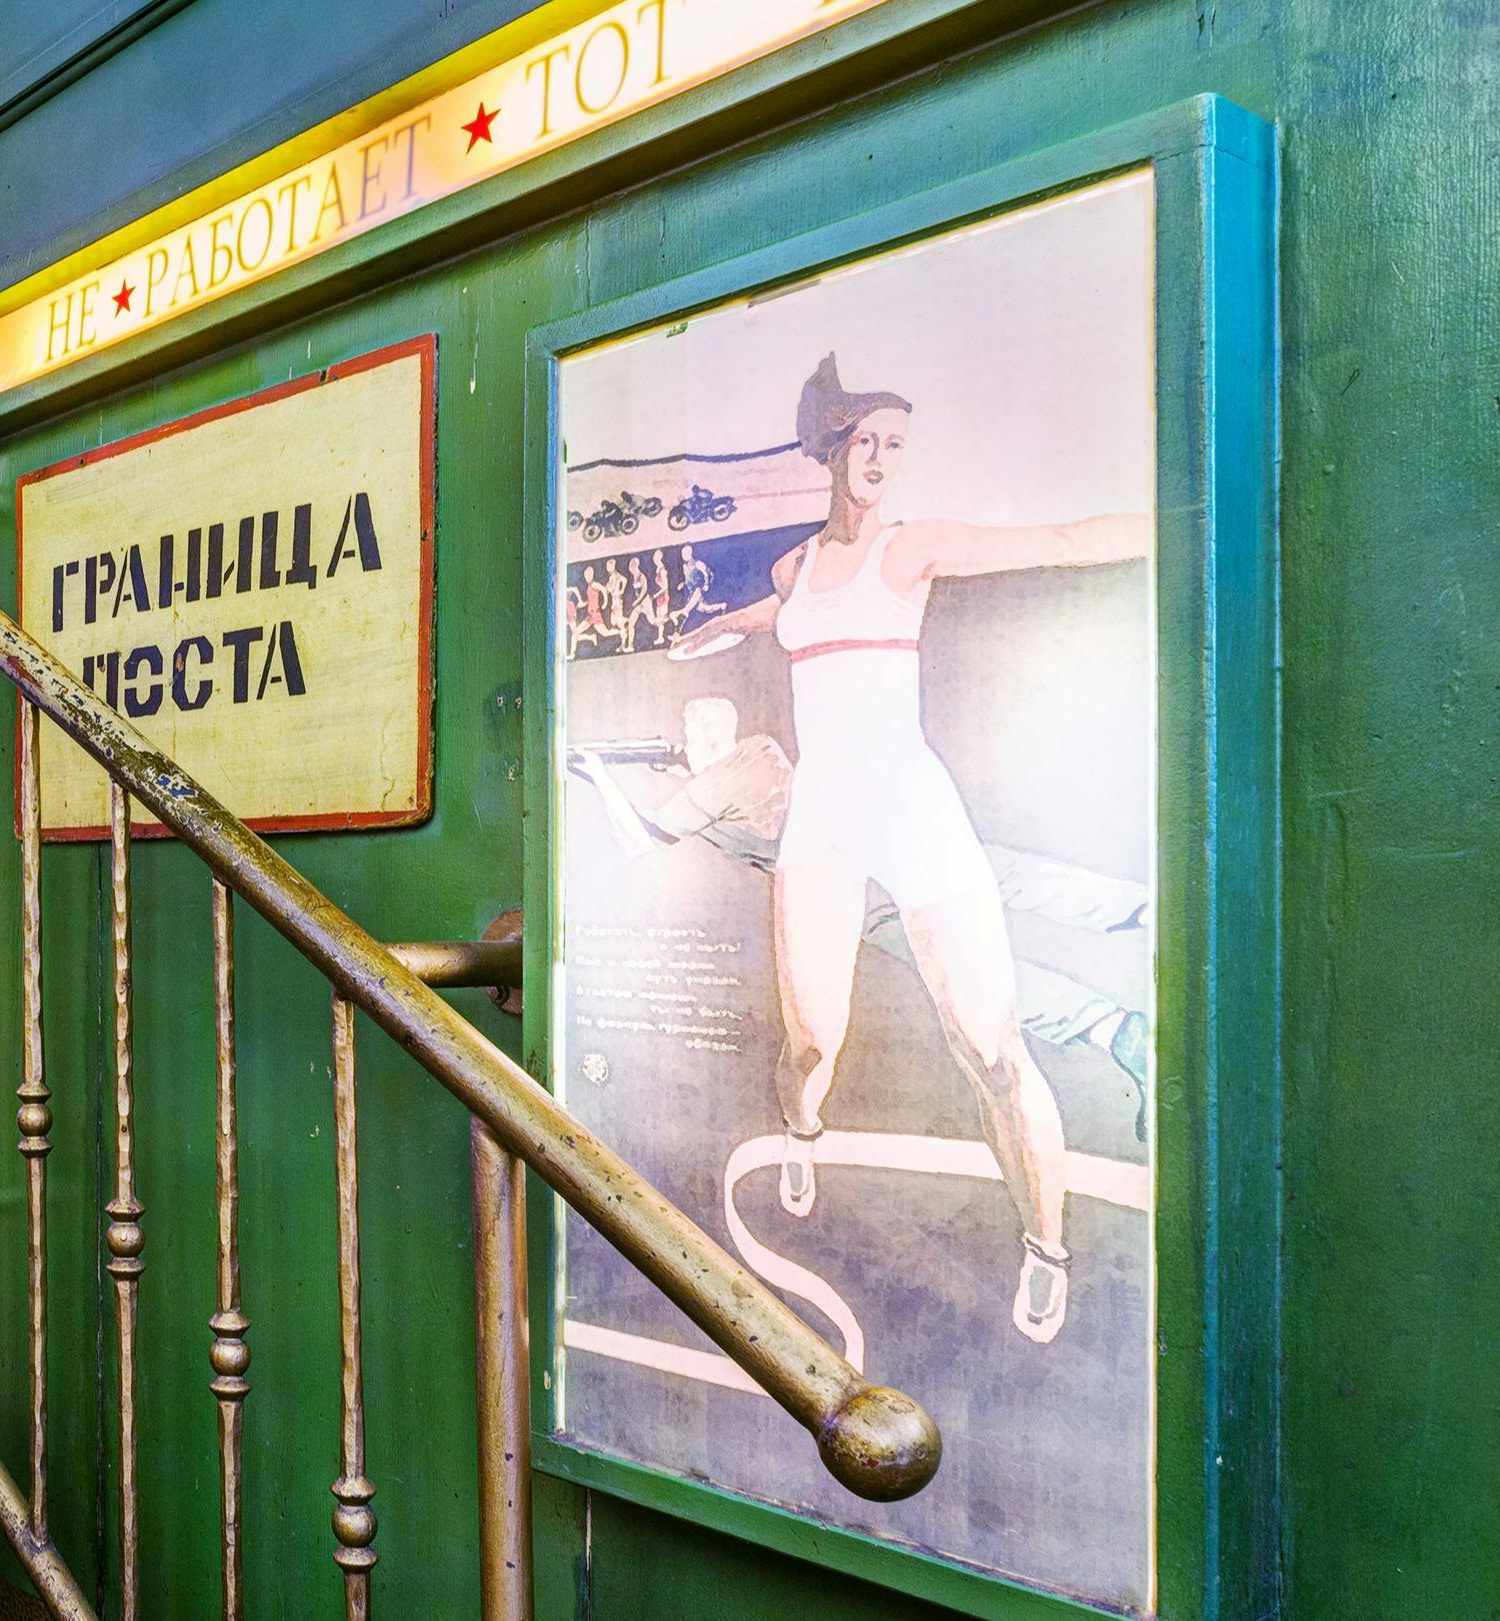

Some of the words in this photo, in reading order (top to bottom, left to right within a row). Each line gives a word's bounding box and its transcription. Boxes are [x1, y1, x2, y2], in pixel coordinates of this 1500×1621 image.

[43, 279, 101, 363] НЕ
[142, 112, 432, 319] РАБОТАЕТ
[524, 0, 690, 140] ТОТ
[52, 492, 383, 632] ГРАНИЦА
[82, 620, 307, 718] ПОСТА
